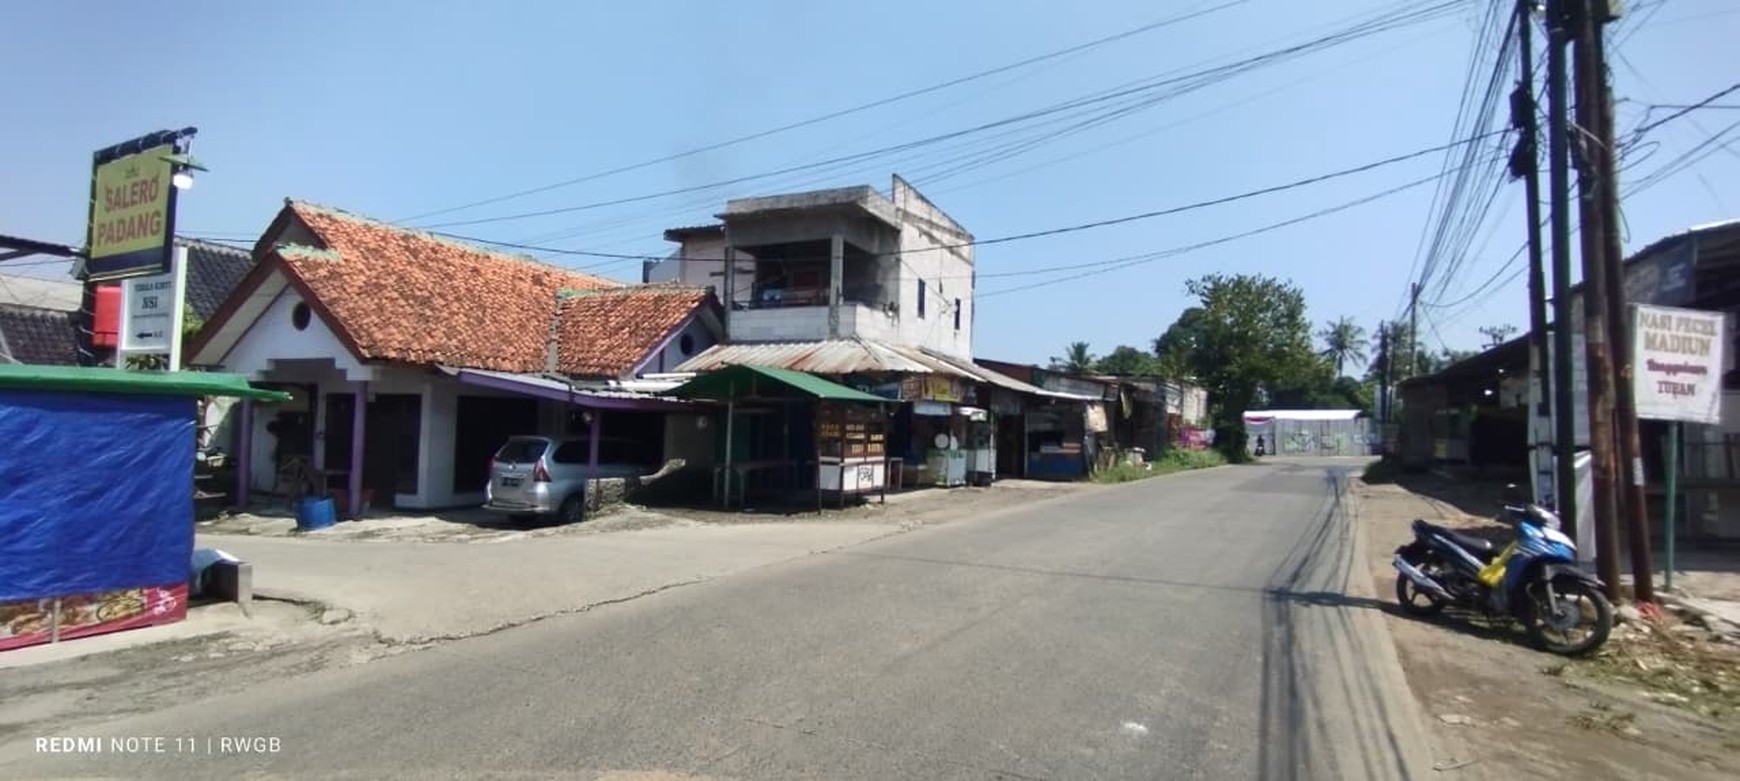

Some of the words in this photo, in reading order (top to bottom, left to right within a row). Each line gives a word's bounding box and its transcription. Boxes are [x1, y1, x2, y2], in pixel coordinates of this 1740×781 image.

[104, 176, 159, 212] SALERO
[97, 210, 161, 245] PADANG
[1640, 312, 1672, 331] NASI
[1675, 316, 1717, 336] PECEL
[1644, 332, 1711, 356] MADIUN
